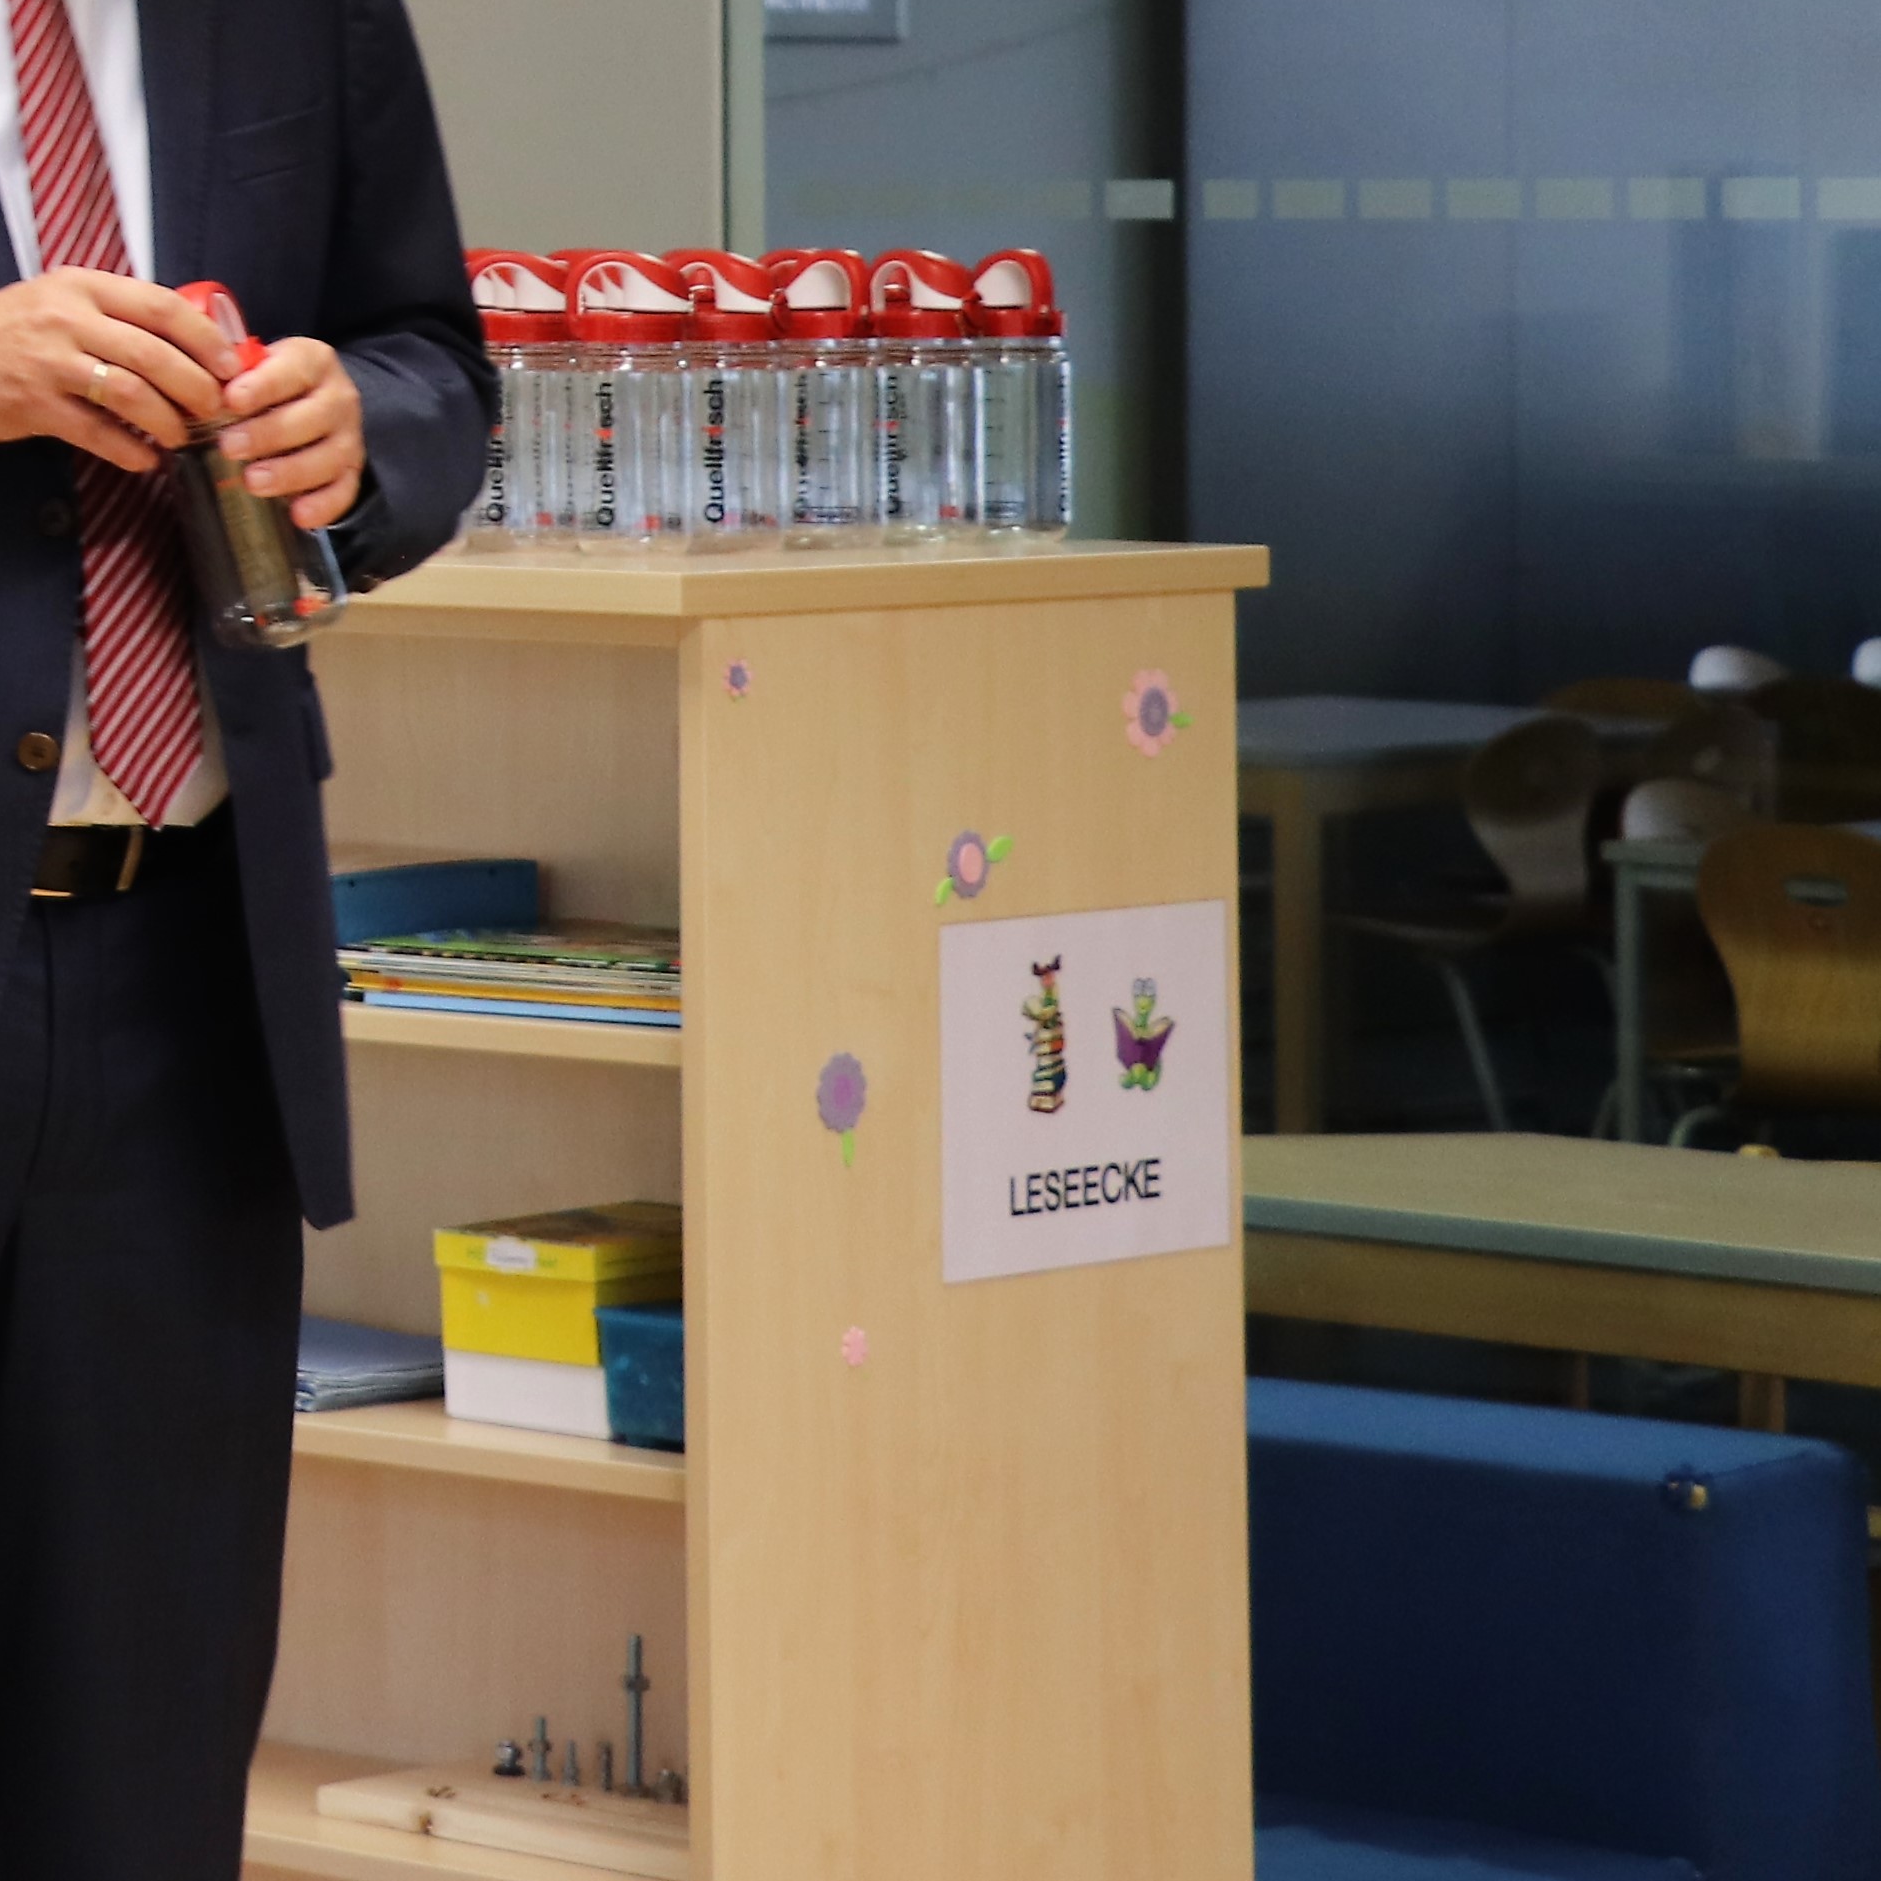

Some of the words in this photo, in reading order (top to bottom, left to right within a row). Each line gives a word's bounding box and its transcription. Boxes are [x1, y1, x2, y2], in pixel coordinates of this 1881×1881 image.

[595, 381, 613, 526] Quellfrisch
[703, 379, 725, 523] Quellfrisch
[1009, 1157, 1162, 1217] LESEECKE
